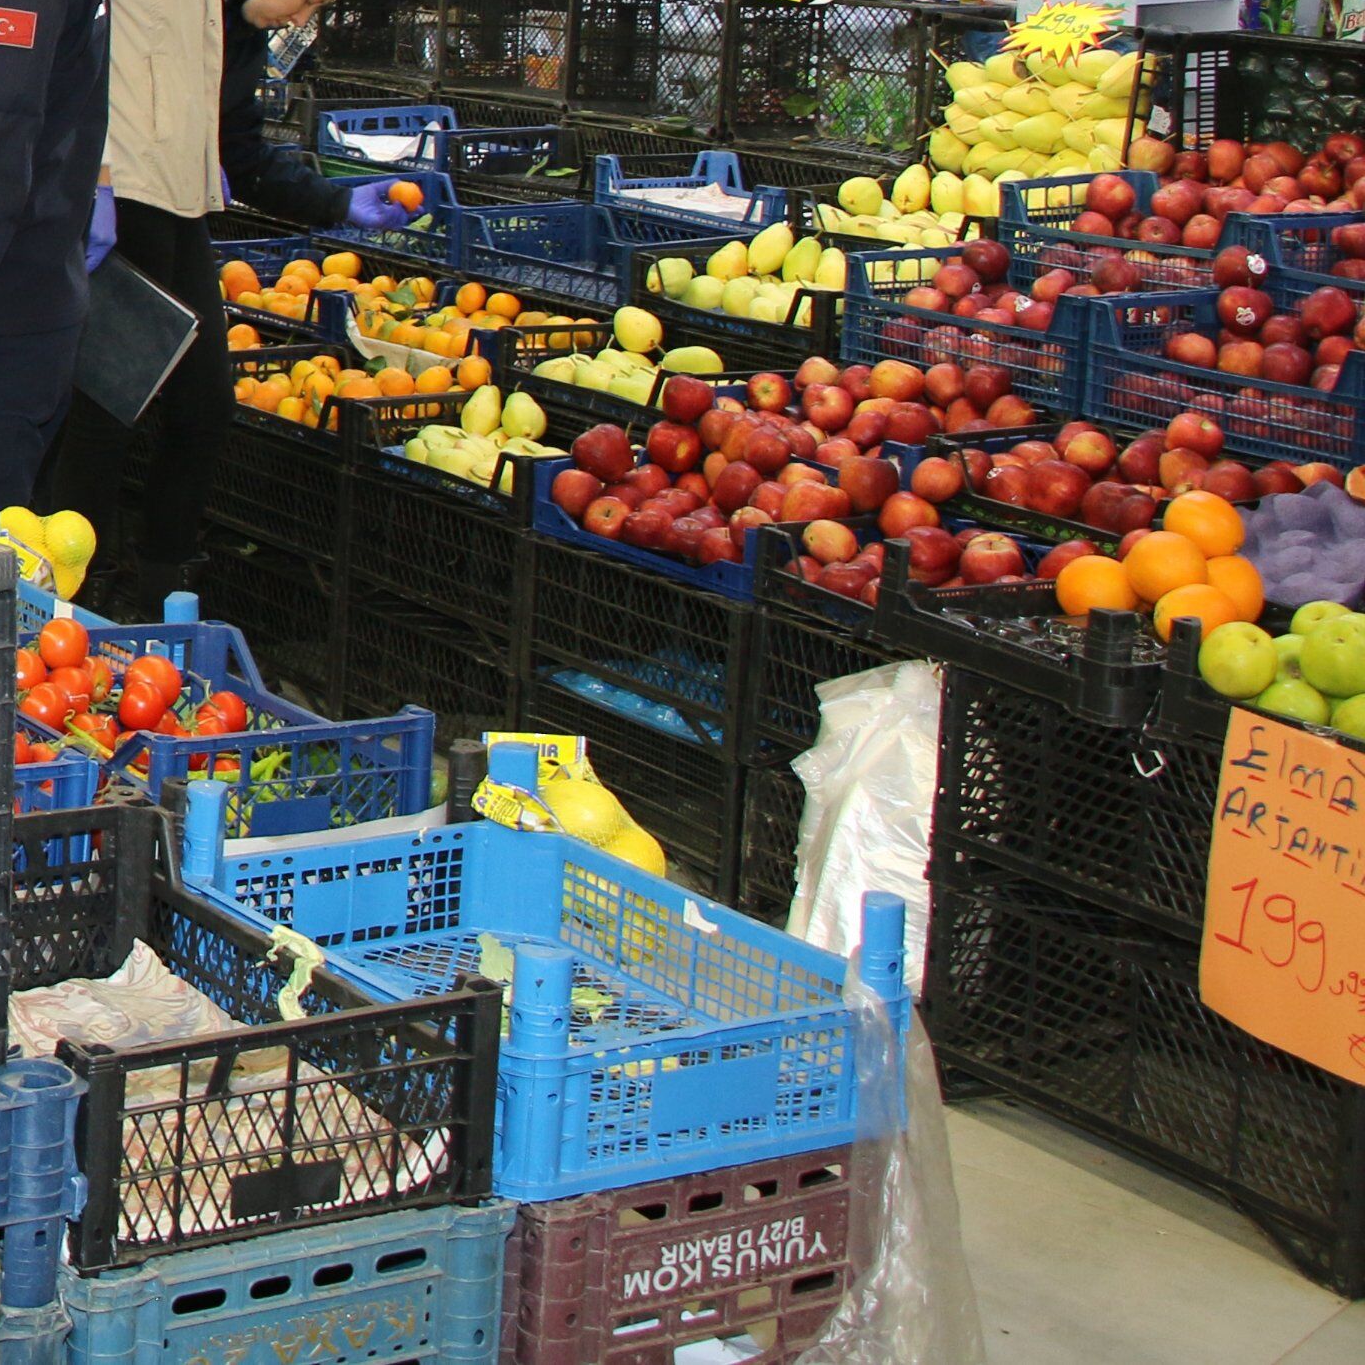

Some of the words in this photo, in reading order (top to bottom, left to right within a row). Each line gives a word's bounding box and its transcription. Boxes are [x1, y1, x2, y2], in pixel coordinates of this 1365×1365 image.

[737, 1229, 752, 1249] D
[757, 1216, 804, 1245] B/27
[660, 1234, 732, 1265] BAKIR
[712, 1231, 827, 1278] YUNUS
[623, 1260, 702, 1299] KOM
